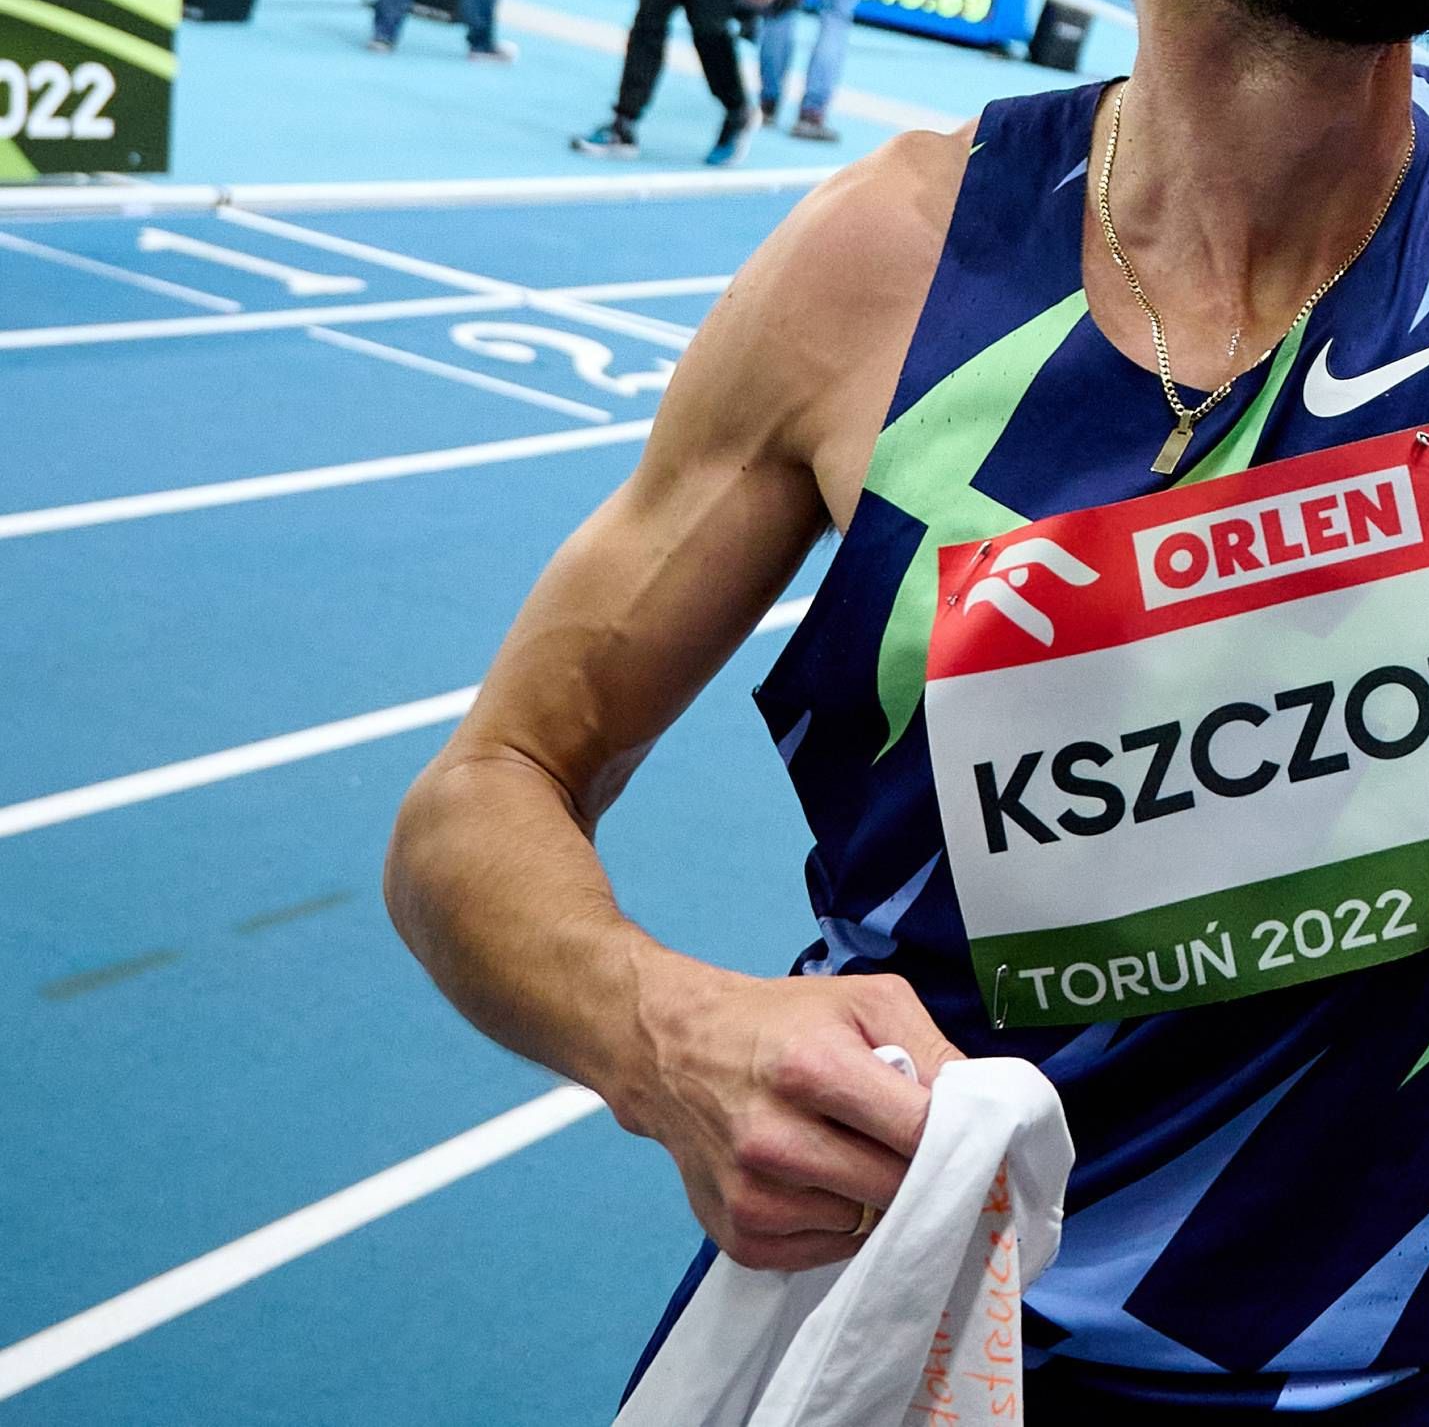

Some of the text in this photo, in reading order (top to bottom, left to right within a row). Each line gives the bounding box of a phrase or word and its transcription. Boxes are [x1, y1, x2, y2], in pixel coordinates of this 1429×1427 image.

[1152, 482, 1405, 590] ORLEN
[1018, 889, 1419, 1012] TORUŃ 2022
